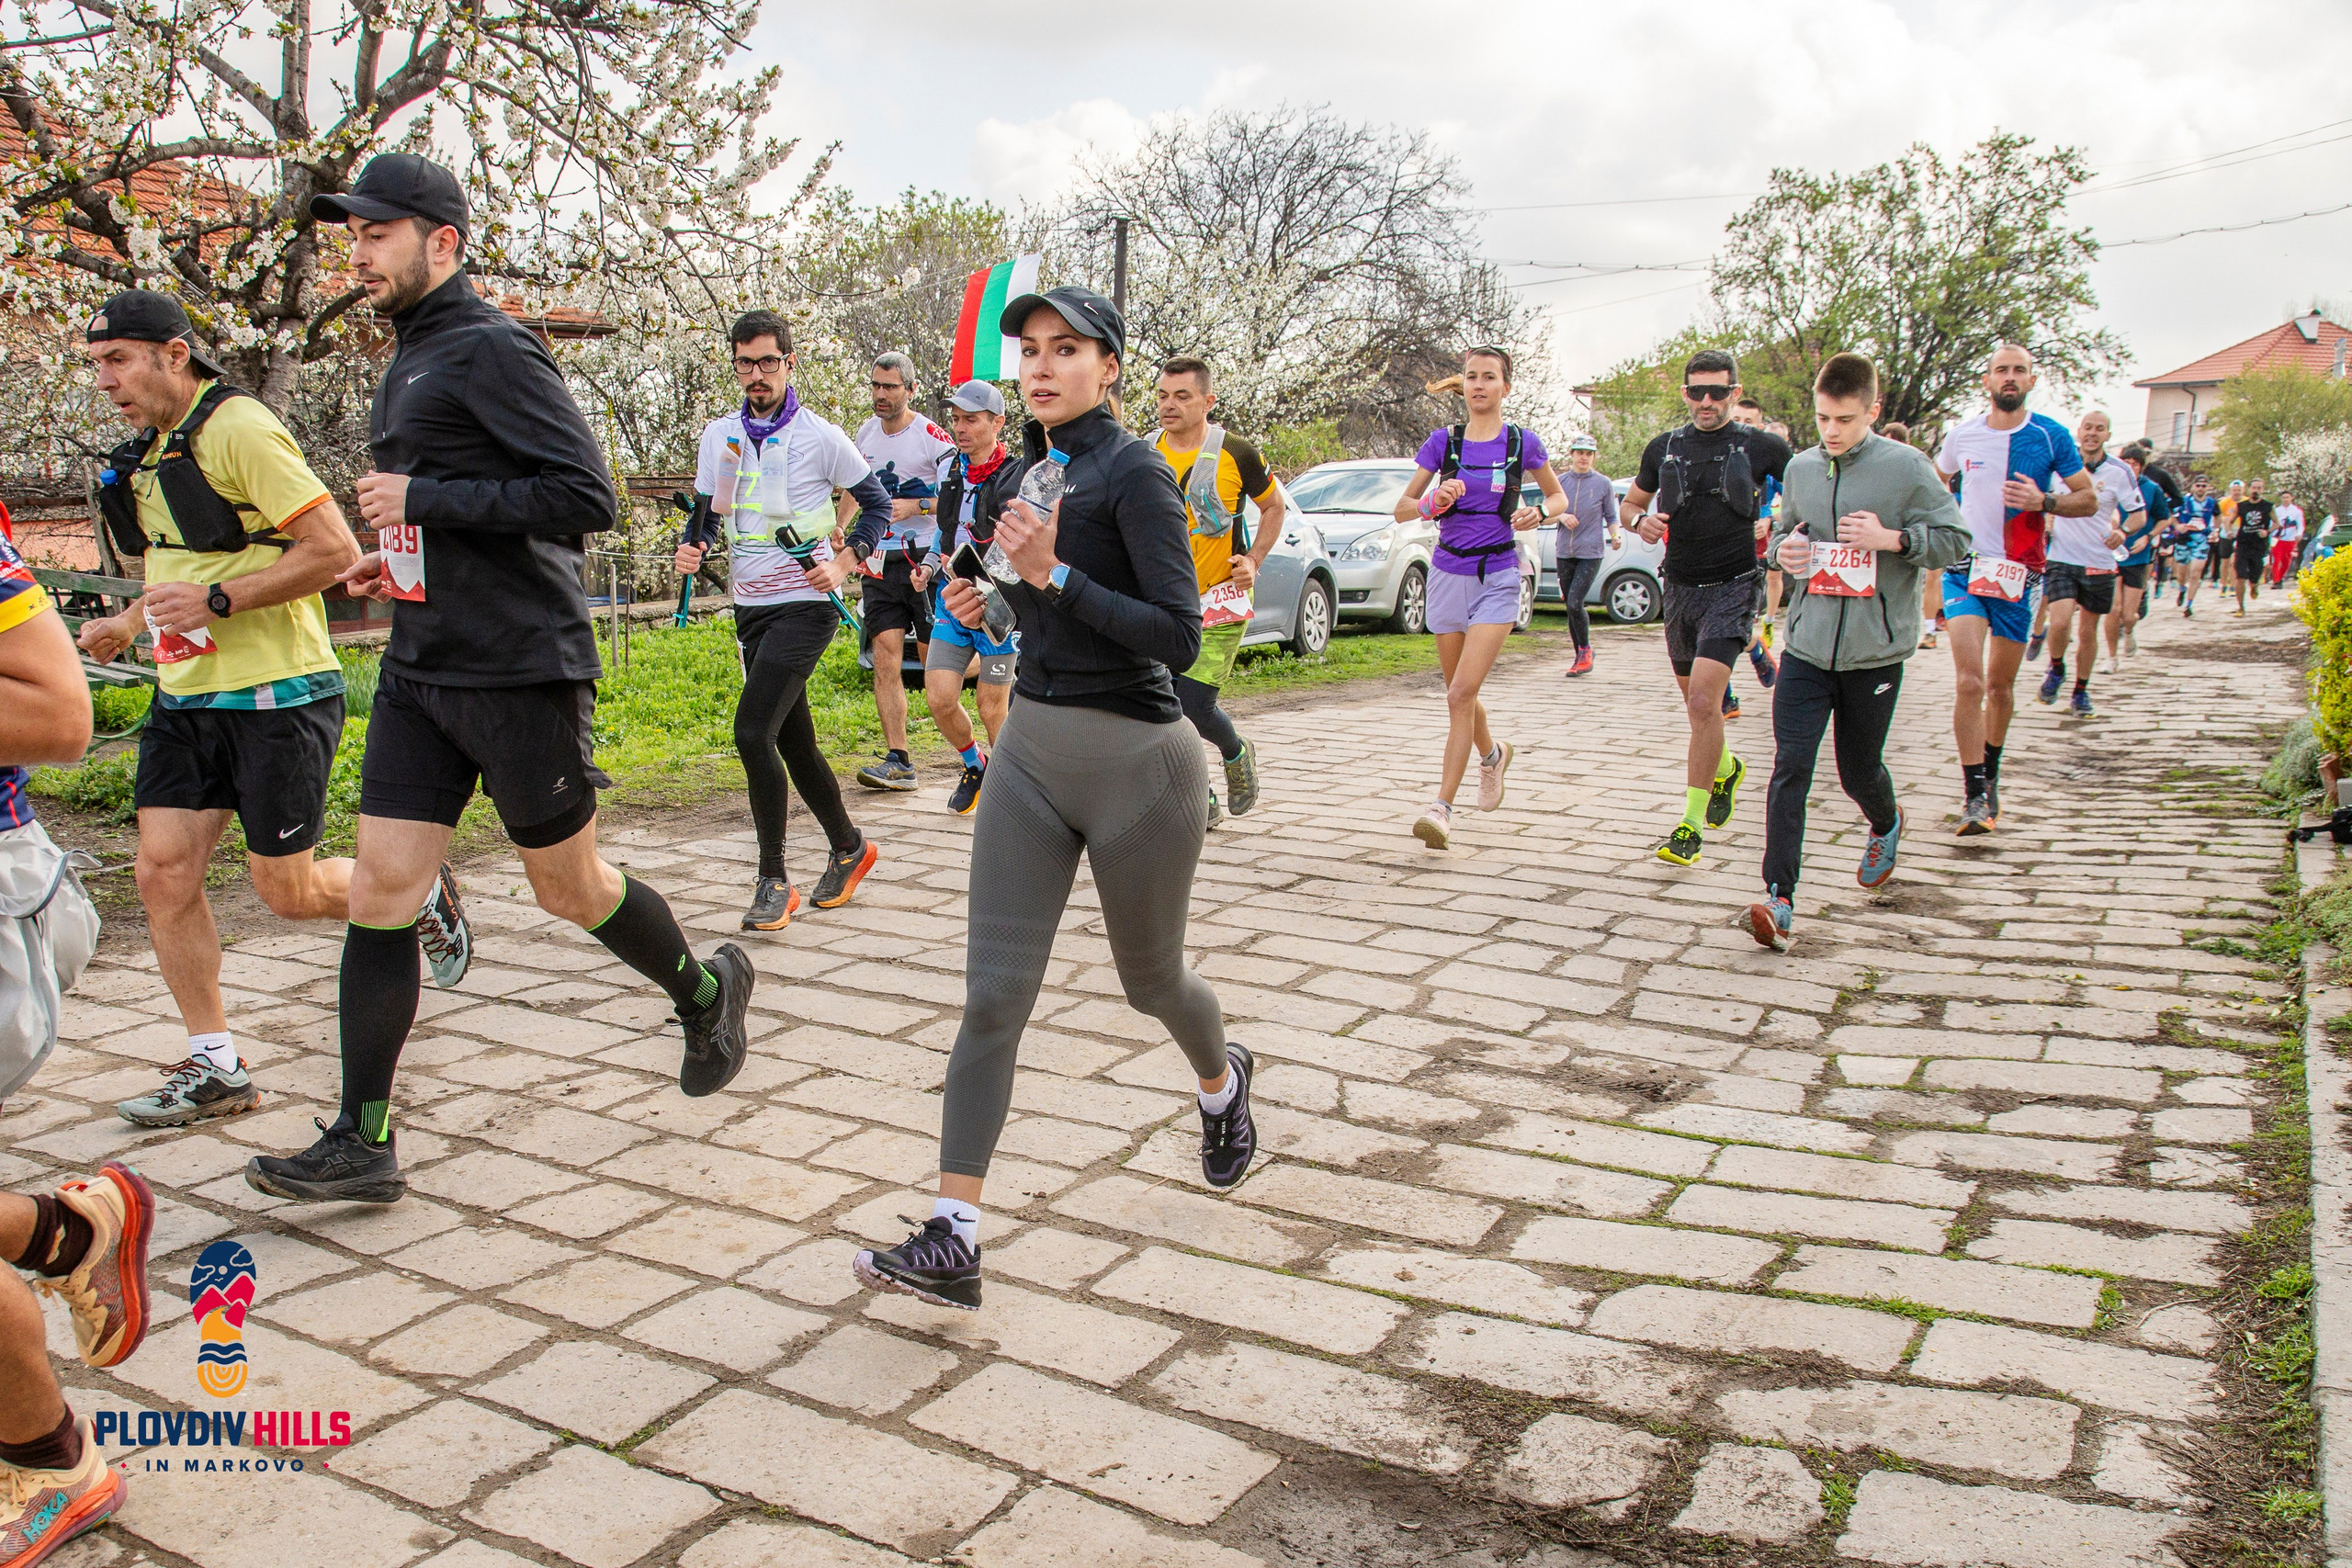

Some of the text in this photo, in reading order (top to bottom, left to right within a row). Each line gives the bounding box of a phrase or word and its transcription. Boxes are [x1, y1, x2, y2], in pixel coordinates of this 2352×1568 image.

[1829, 548, 1872, 569] 2264
[1995, 563, 2025, 582] 2197
[1212, 584, 1245, 604] 2358
[21, 1491, 69, 1544] HOKA
